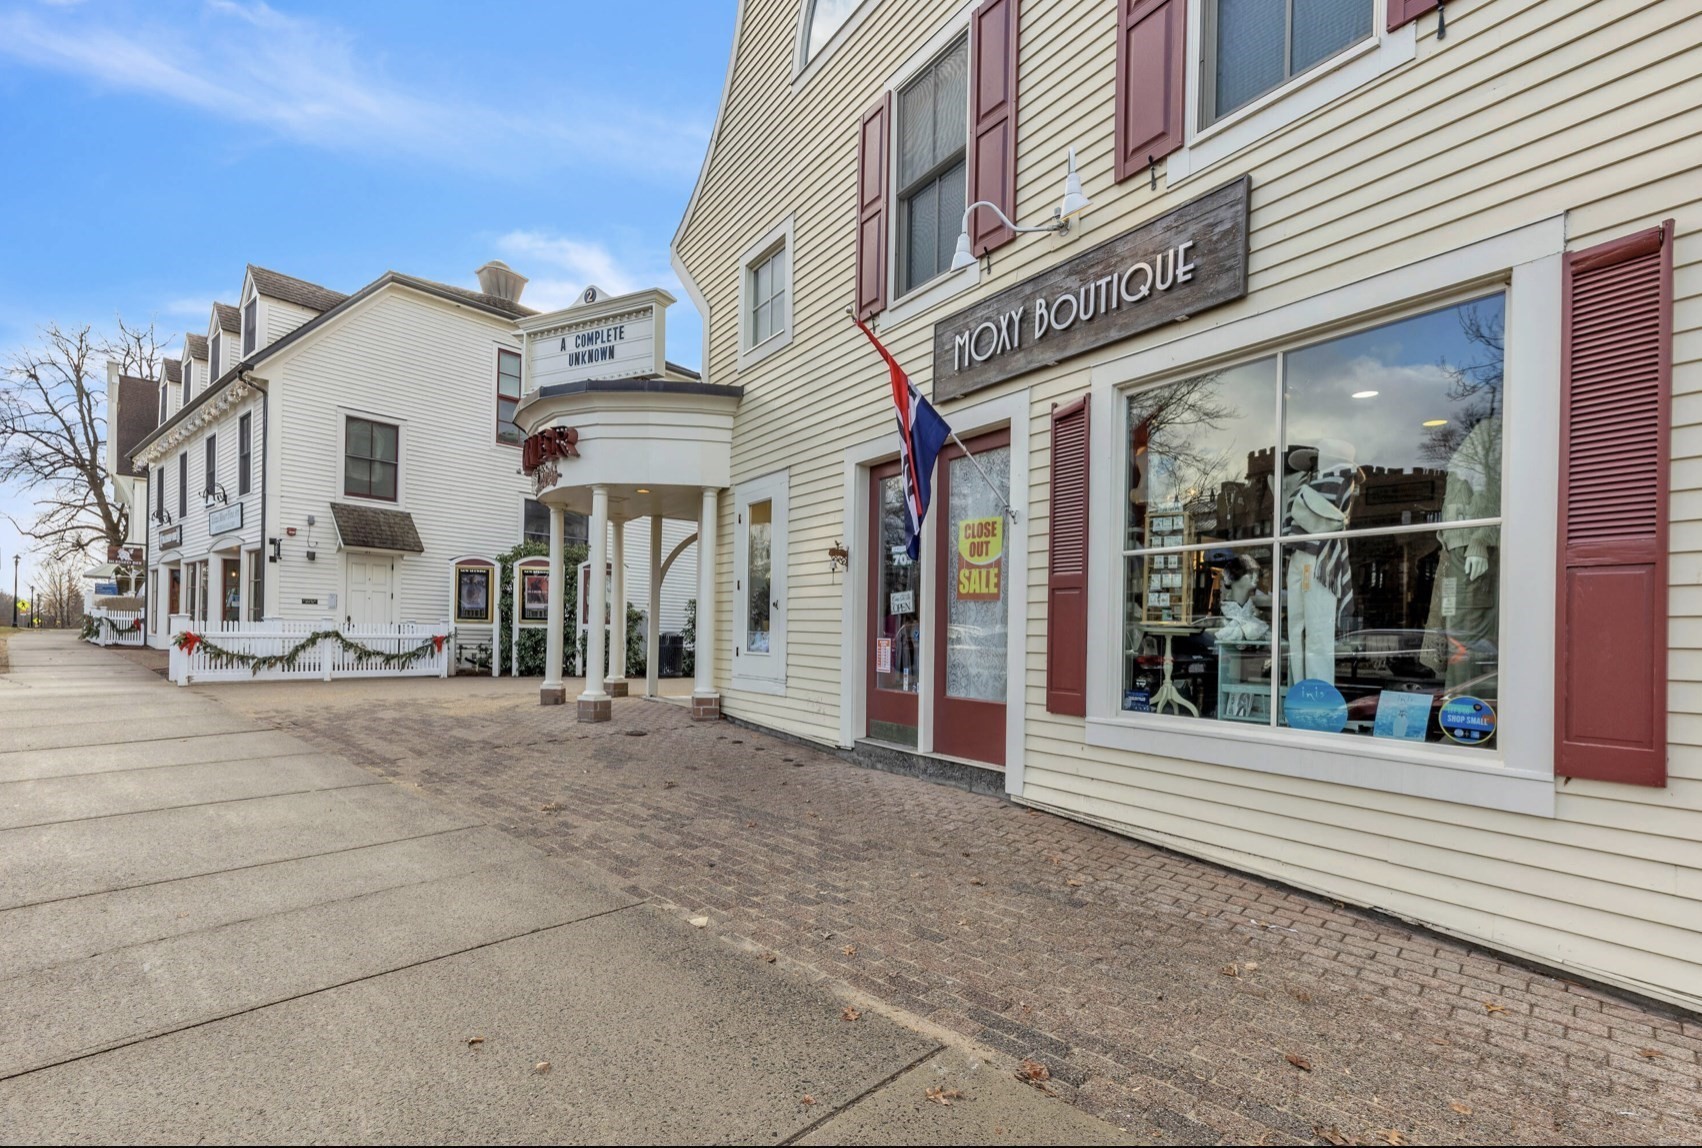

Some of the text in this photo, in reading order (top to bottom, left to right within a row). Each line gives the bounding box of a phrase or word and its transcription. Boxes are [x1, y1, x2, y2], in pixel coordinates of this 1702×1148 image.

[586, 290, 595, 302] 2
[560, 325, 625, 352] A COMPLETE
[954, 305, 1025, 371] MOXY
[568, 345, 615, 367] UNKNOWN
[964, 520, 997, 539] CLOSE
[969, 540, 990, 557] OUT
[959, 567, 998, 594] SALE
[892, 602, 911, 613] OPEN
[1447, 714, 1488, 726] SHOP SMALL
